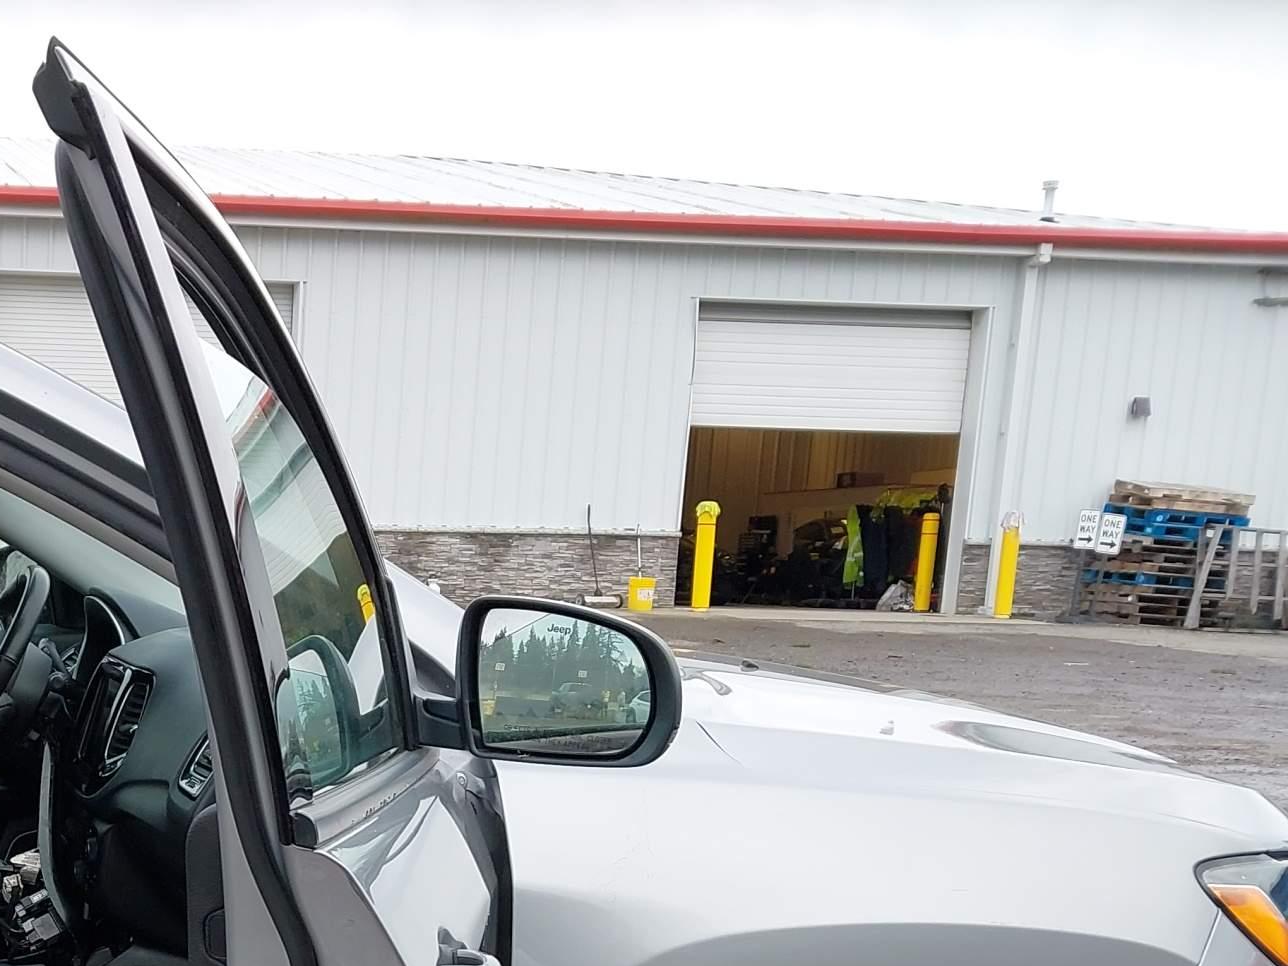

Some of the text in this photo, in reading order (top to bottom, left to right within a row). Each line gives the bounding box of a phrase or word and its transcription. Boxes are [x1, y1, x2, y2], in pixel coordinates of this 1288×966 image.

[1081, 514, 1097, 523] ONE
[1104, 519, 1121, 529] ONE
[1080, 525, 1096, 533] WAY
[1102, 530, 1120, 538] WAY
[547, 623, 572, 635] Jeep
